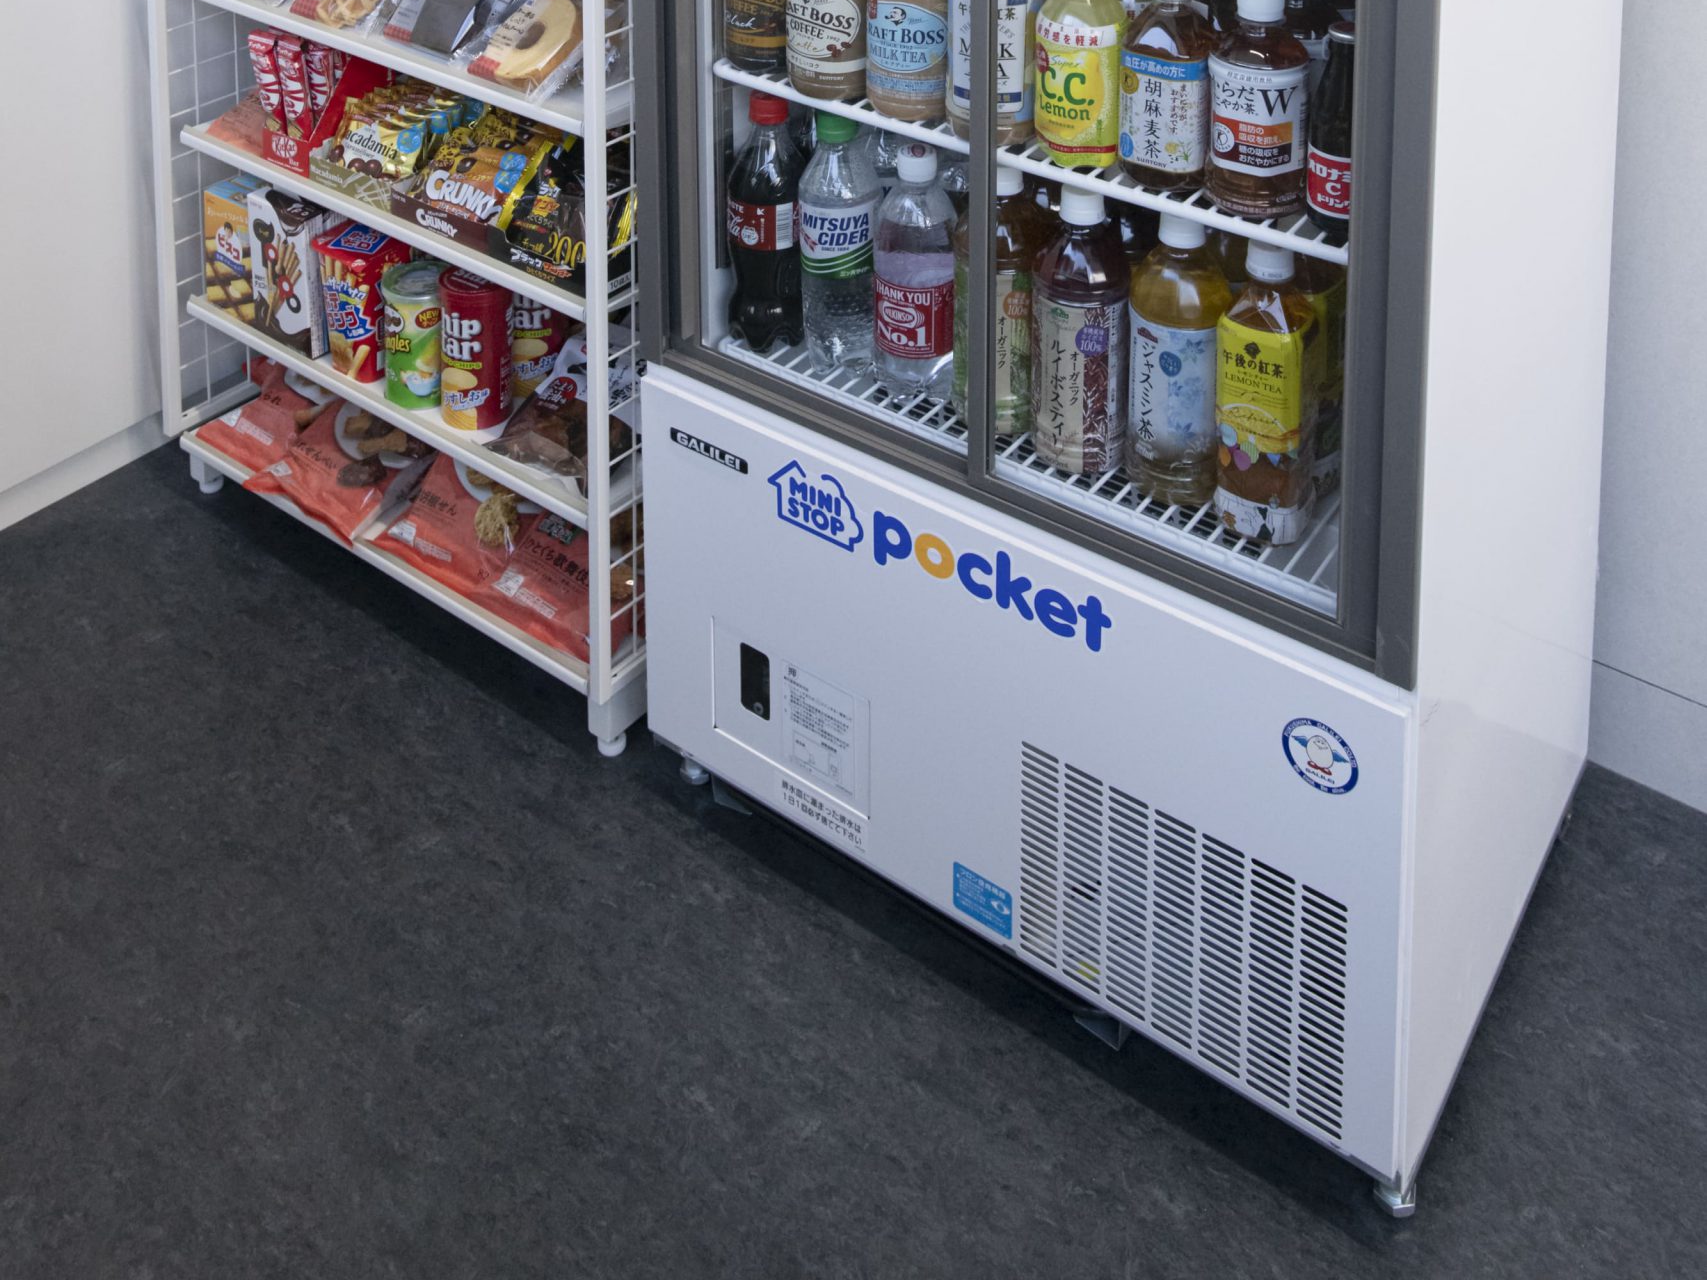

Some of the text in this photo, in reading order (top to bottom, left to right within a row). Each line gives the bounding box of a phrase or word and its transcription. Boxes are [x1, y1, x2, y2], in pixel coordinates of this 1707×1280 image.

[790, 18, 825, 40] COFFEE
[810, 6, 855, 30] BOSS
[901, 28, 945, 45] BOSS
[869, 44, 928, 64] MILK TEA
[1125, 55, 1187, 78] 血圧が高めの方に
[1041, 66, 1096, 107] C.C.
[1039, 94, 1091, 121] Lemon
[1256, 85, 1299, 117] W
[1143, 78, 1163, 160] 胡麻麦茶
[1136, 156, 1168, 169] SUNTORY
[425, 169, 503, 221] CRUNKY
[1325, 183, 1342, 195] C
[416, 207, 458, 239] CRUNKY
[802, 211, 870, 228] MITSUYA
[217, 234, 241, 262] ビスコ
[817, 228, 869, 247] CIDER
[875, 278, 931, 306] THANK YOU
[418, 309, 439, 322] NEW
[876, 320, 929, 347] No.1
[1223, 349, 1287, 380] 午後の紅茶
[1050, 339, 1068, 446] ルイボスティー
[1069, 351, 1081, 407] オーガニック
[1136, 341, 1155, 441] ジャスミン茶
[1225, 372, 1282, 395] LEMON TEA
[676, 431, 742, 472] GALILEI
[789, 476, 843, 514] MINI
[787, 499, 845, 537] STOP
[873, 510, 1112, 653] pocket
[1305, 767, 1336, 785] GALILEI
